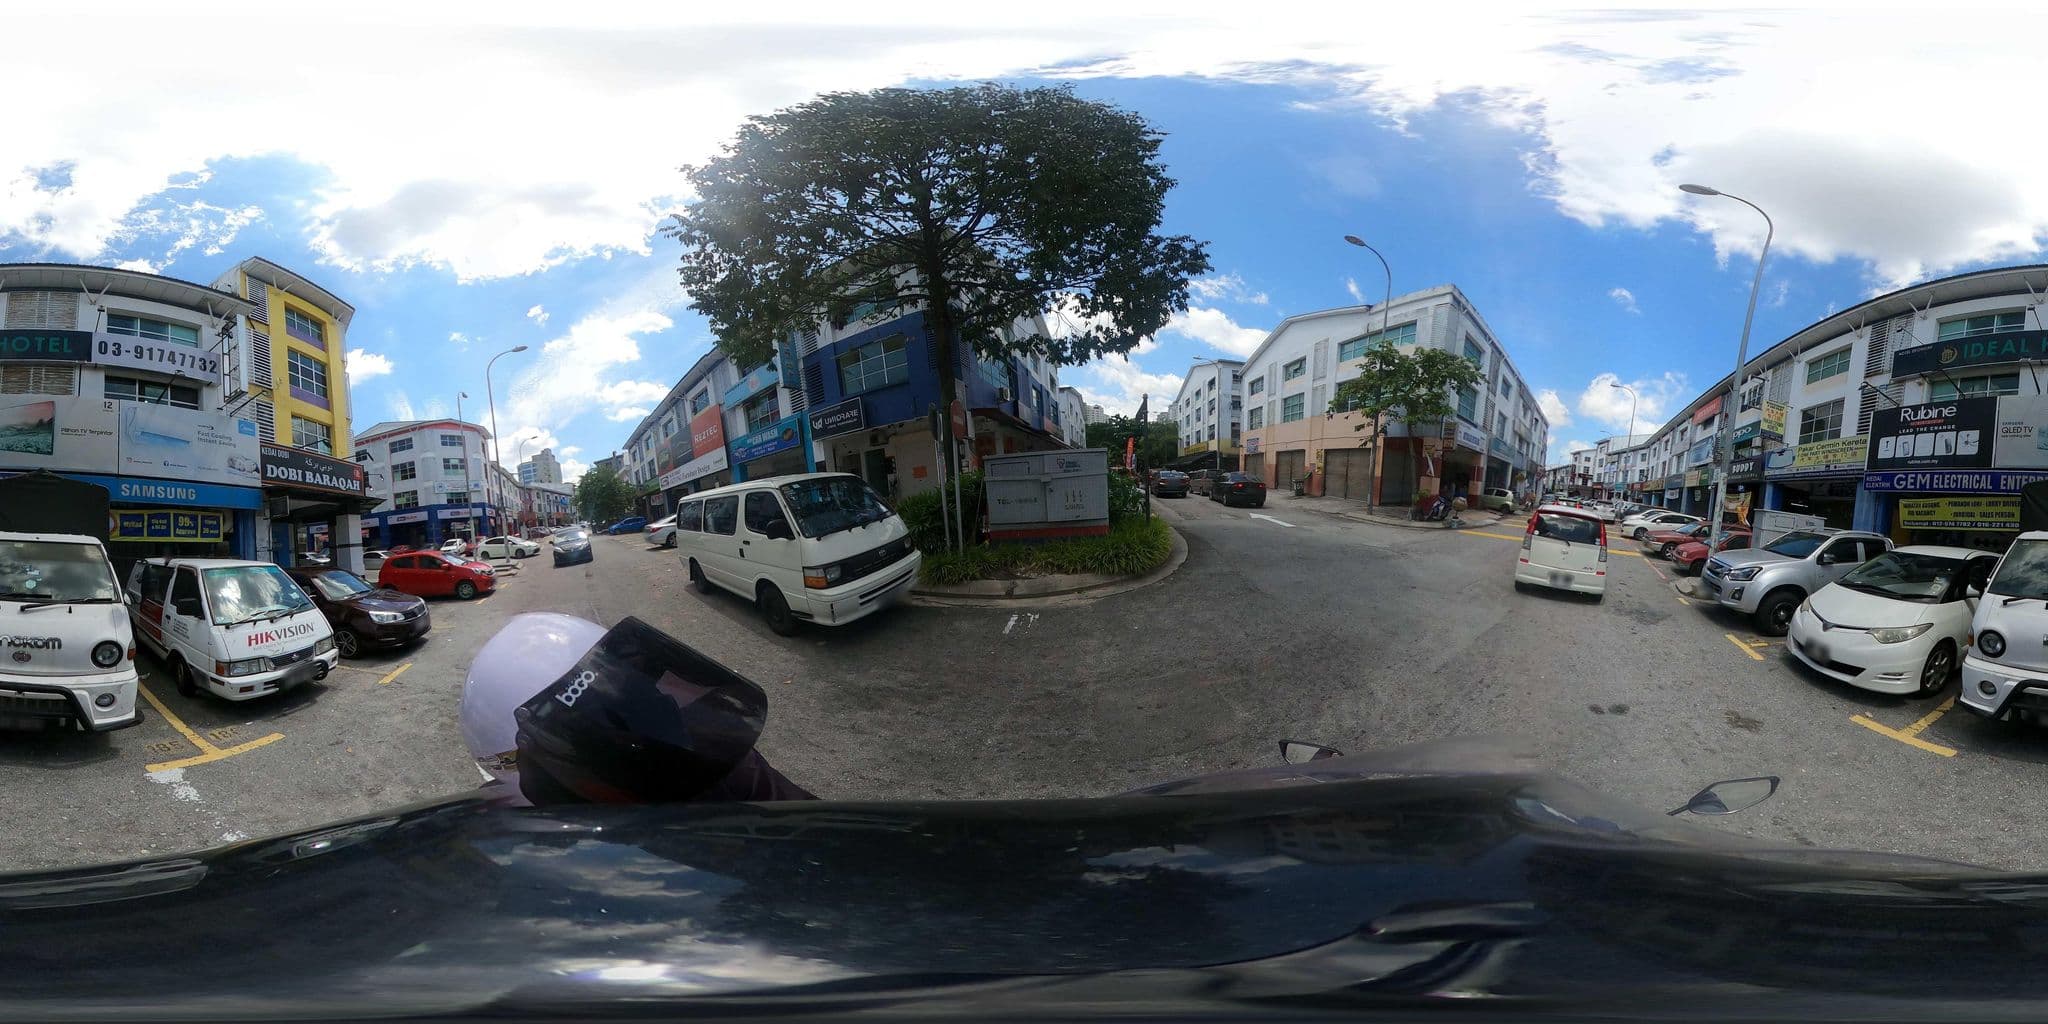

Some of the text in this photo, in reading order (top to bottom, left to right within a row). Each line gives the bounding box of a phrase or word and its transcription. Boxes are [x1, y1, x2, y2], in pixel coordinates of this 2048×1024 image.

[1963, 337, 2029, 358] IDEAL
[98, 340, 217, 373] 03-91747732
[103, 401, 113, 409] 12
[1901, 405, 1957, 422] Rubine
[694, 424, 718, 443] REZTEC
[2001, 425, 2034, 434] QLED TV
[1816, 442, 1840, 450] Cermin
[1841, 438, 1867, 447] Kereta
[266, 464, 303, 482] DOBI
[305, 473, 361, 490] BARAQAH
[1894, 473, 1930, 489] GEM
[1933, 474, 1992, 490] ELECTRICAL
[121, 483, 197, 500] SAMSUNG
[247, 622, 315, 647] HIKVISION
